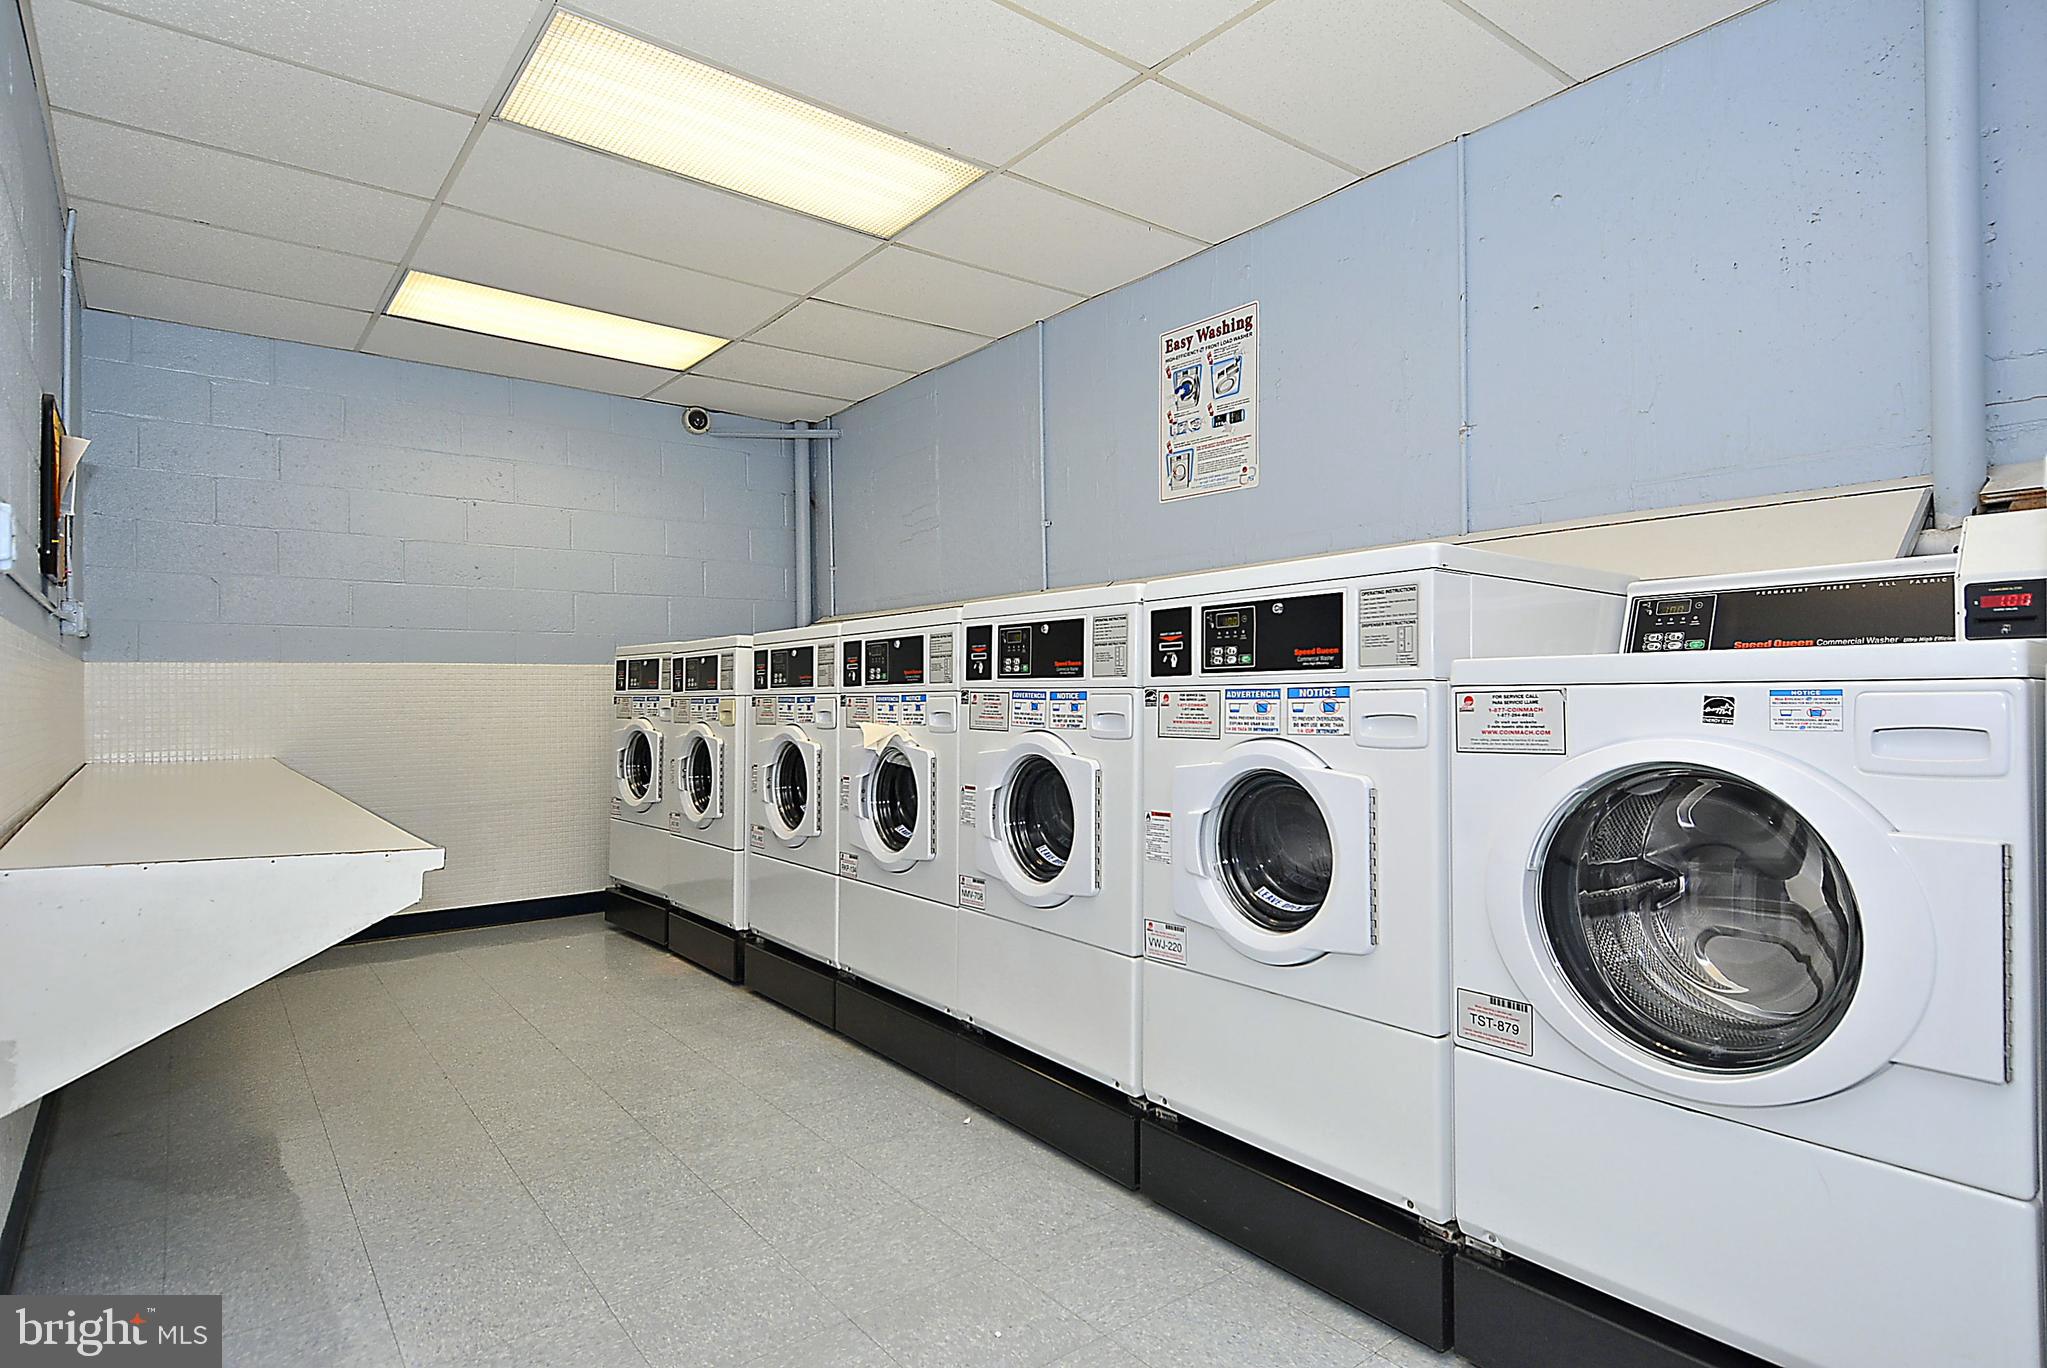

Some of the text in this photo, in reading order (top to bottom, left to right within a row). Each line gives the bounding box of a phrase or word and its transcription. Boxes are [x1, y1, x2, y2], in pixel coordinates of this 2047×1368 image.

[1165, 335, 1194, 354] Easy
[1196, 315, 1254, 343] Washing
[1205, 342, 1219, 350] FRONT
[1220, 338, 1233, 346] LOAD
[1756, 588, 1809, 596] PERMANENT
[1909, 577, 1948, 585] FABRIC
[1734, 640, 1772, 649] Speed
[1773, 639, 1814, 647] Queen
[1816, 637, 1865, 647] Commercial
[1866, 636, 1899, 644] Washer
[1226, 690, 1279, 698] ADVERTENCIA
[1300, 688, 1337, 697] NOTICE
[1148, 937, 1182, 953] VWJ-220
[1470, 1012, 1519, 1036] TST-879
